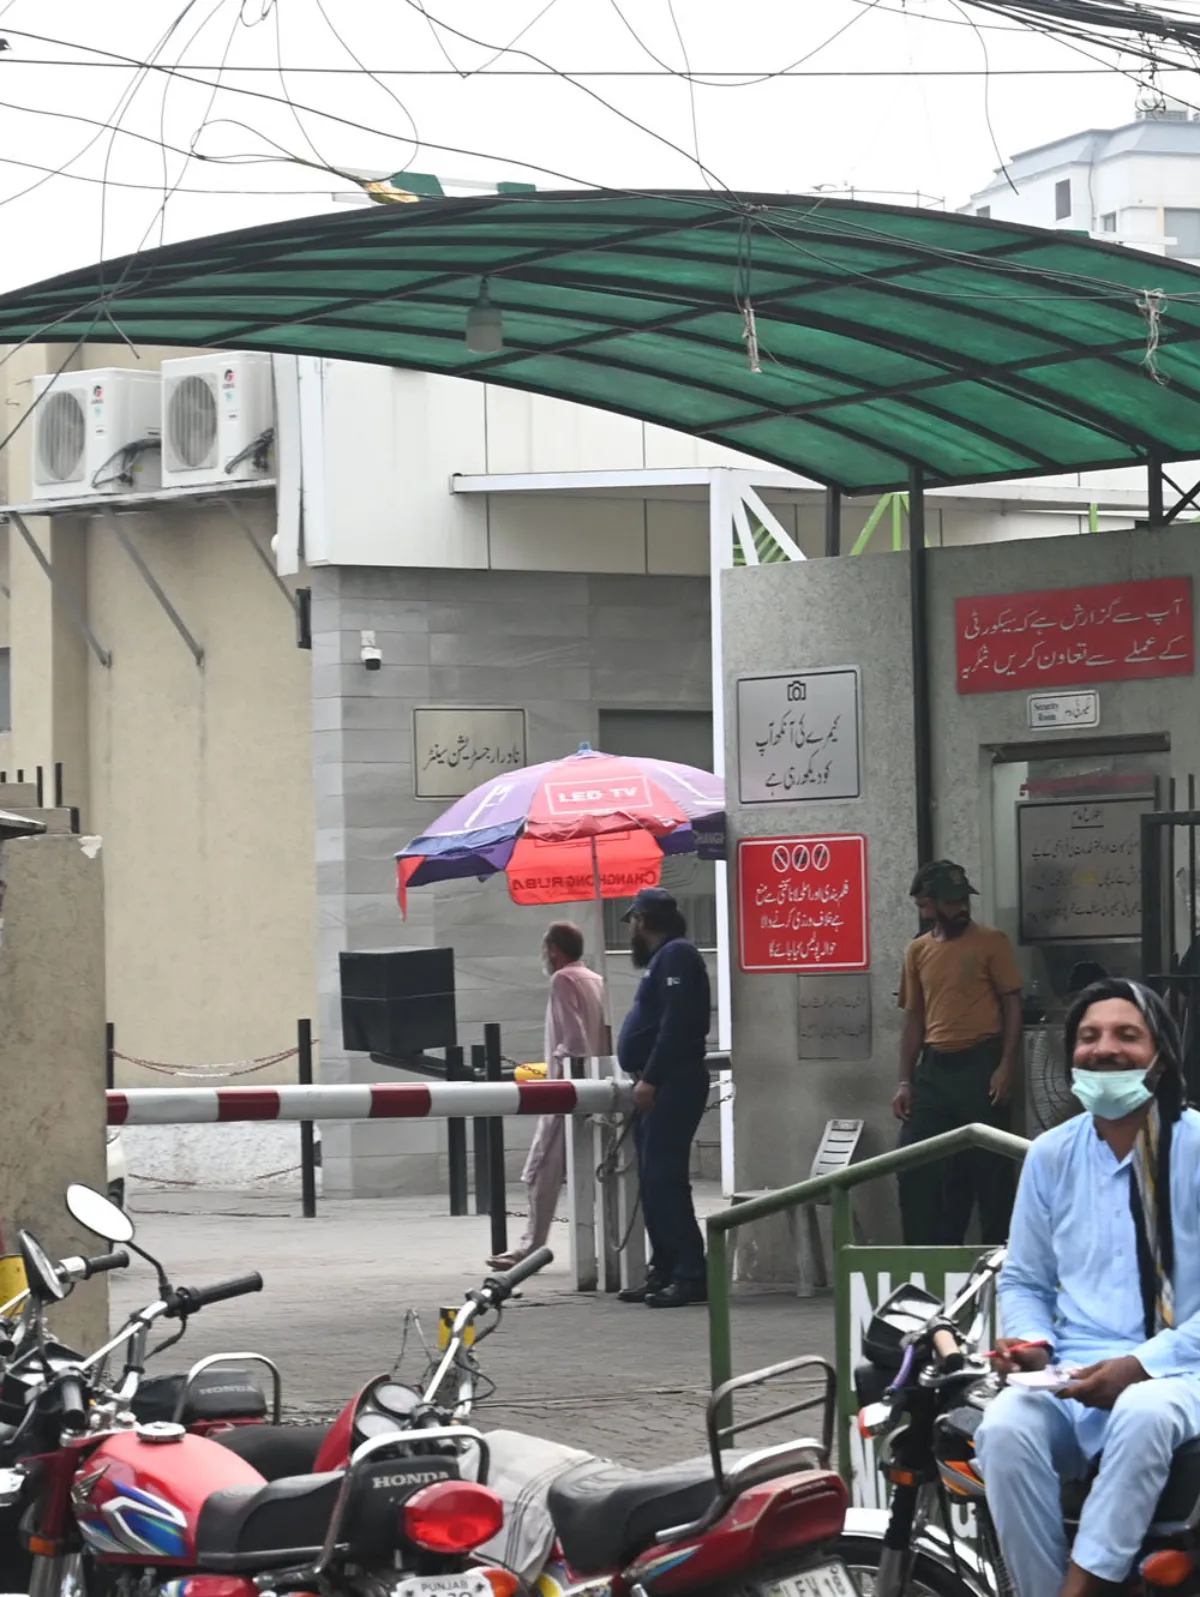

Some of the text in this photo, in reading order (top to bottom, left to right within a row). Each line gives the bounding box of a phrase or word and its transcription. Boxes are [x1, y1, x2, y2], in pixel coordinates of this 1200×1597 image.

[1060, 596, 1121, 631] گزارش
[1112, 609, 1143, 625] سے
[1146, 597, 1184, 626] آپ
[960, 635, 1189, 680] کے عملے سے تعاون کریں شکریہ
[755, 721, 775, 757] آپ
[558, 785, 639, 803] LED TV
[372, 1471, 450, 1489] HONDA
[421, 1580, 469, 1593] PUNJAB
